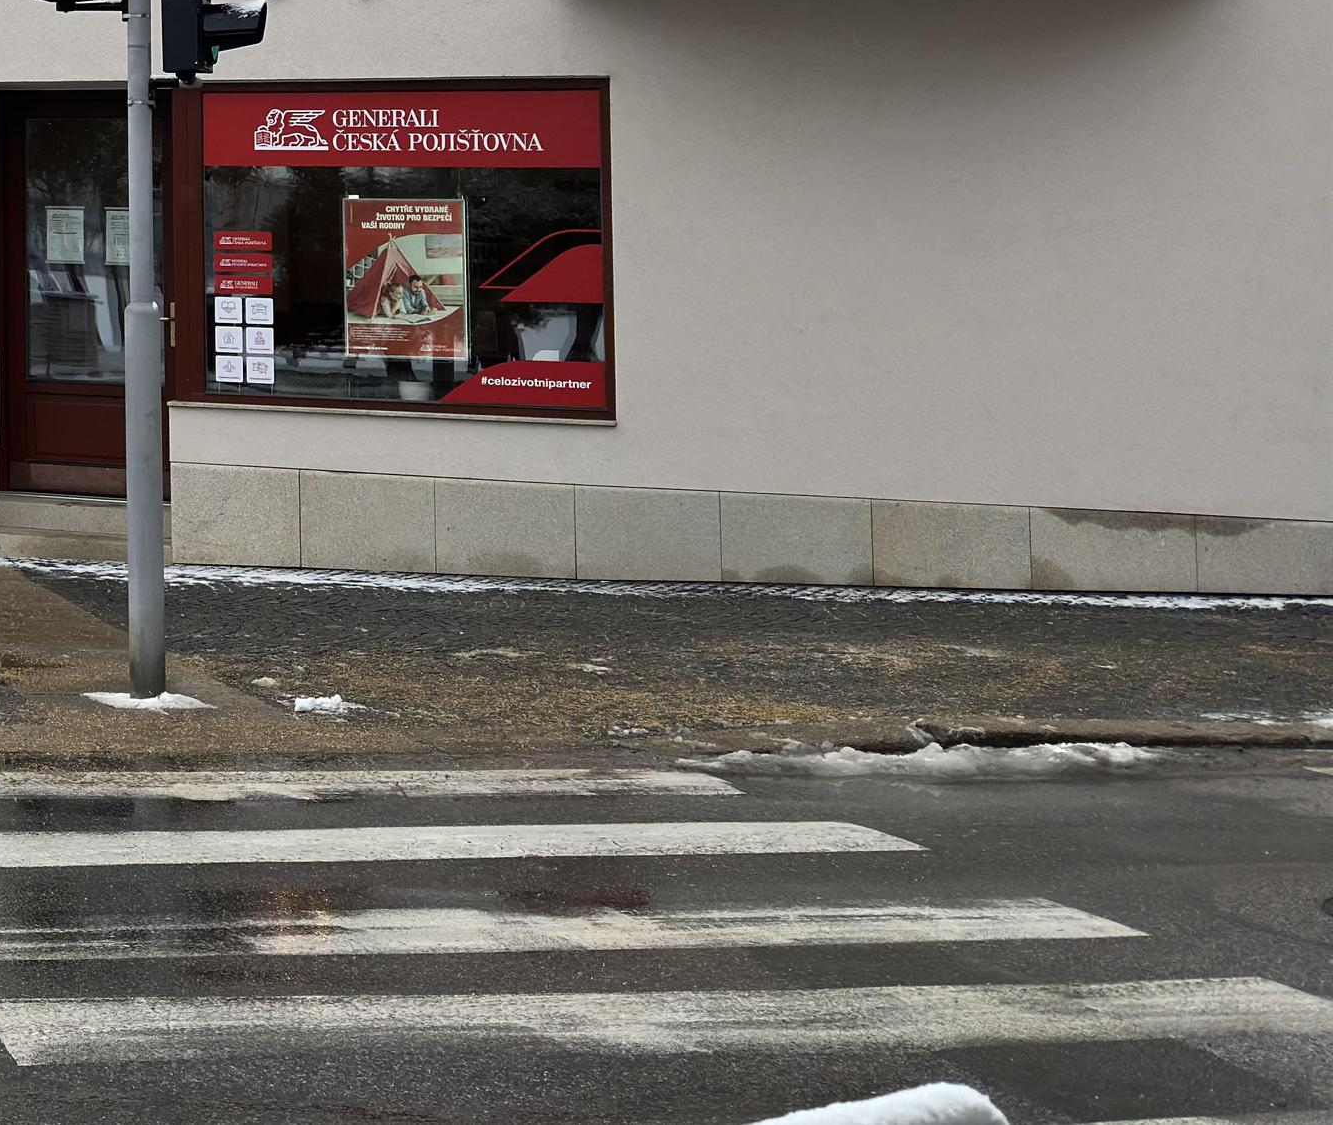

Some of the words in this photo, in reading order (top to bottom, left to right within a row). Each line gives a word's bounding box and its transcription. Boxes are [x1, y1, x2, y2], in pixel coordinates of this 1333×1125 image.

[332, 109, 439, 128] GENERALI
[332, 129, 402, 152] ČESKÁ
[409, 129, 545, 152] POJIŠŤOVNA
[385, 204, 413, 213] CHYTŘE
[415, 204, 449, 213] VYBRANÉ
[376, 213, 405, 221] ŽIVOTKO
[423, 213, 452, 222] BEZPEČÍ
[361, 221, 377, 229] VAŠÍ
[481, 376, 592, 389] #celozivotnipartner
